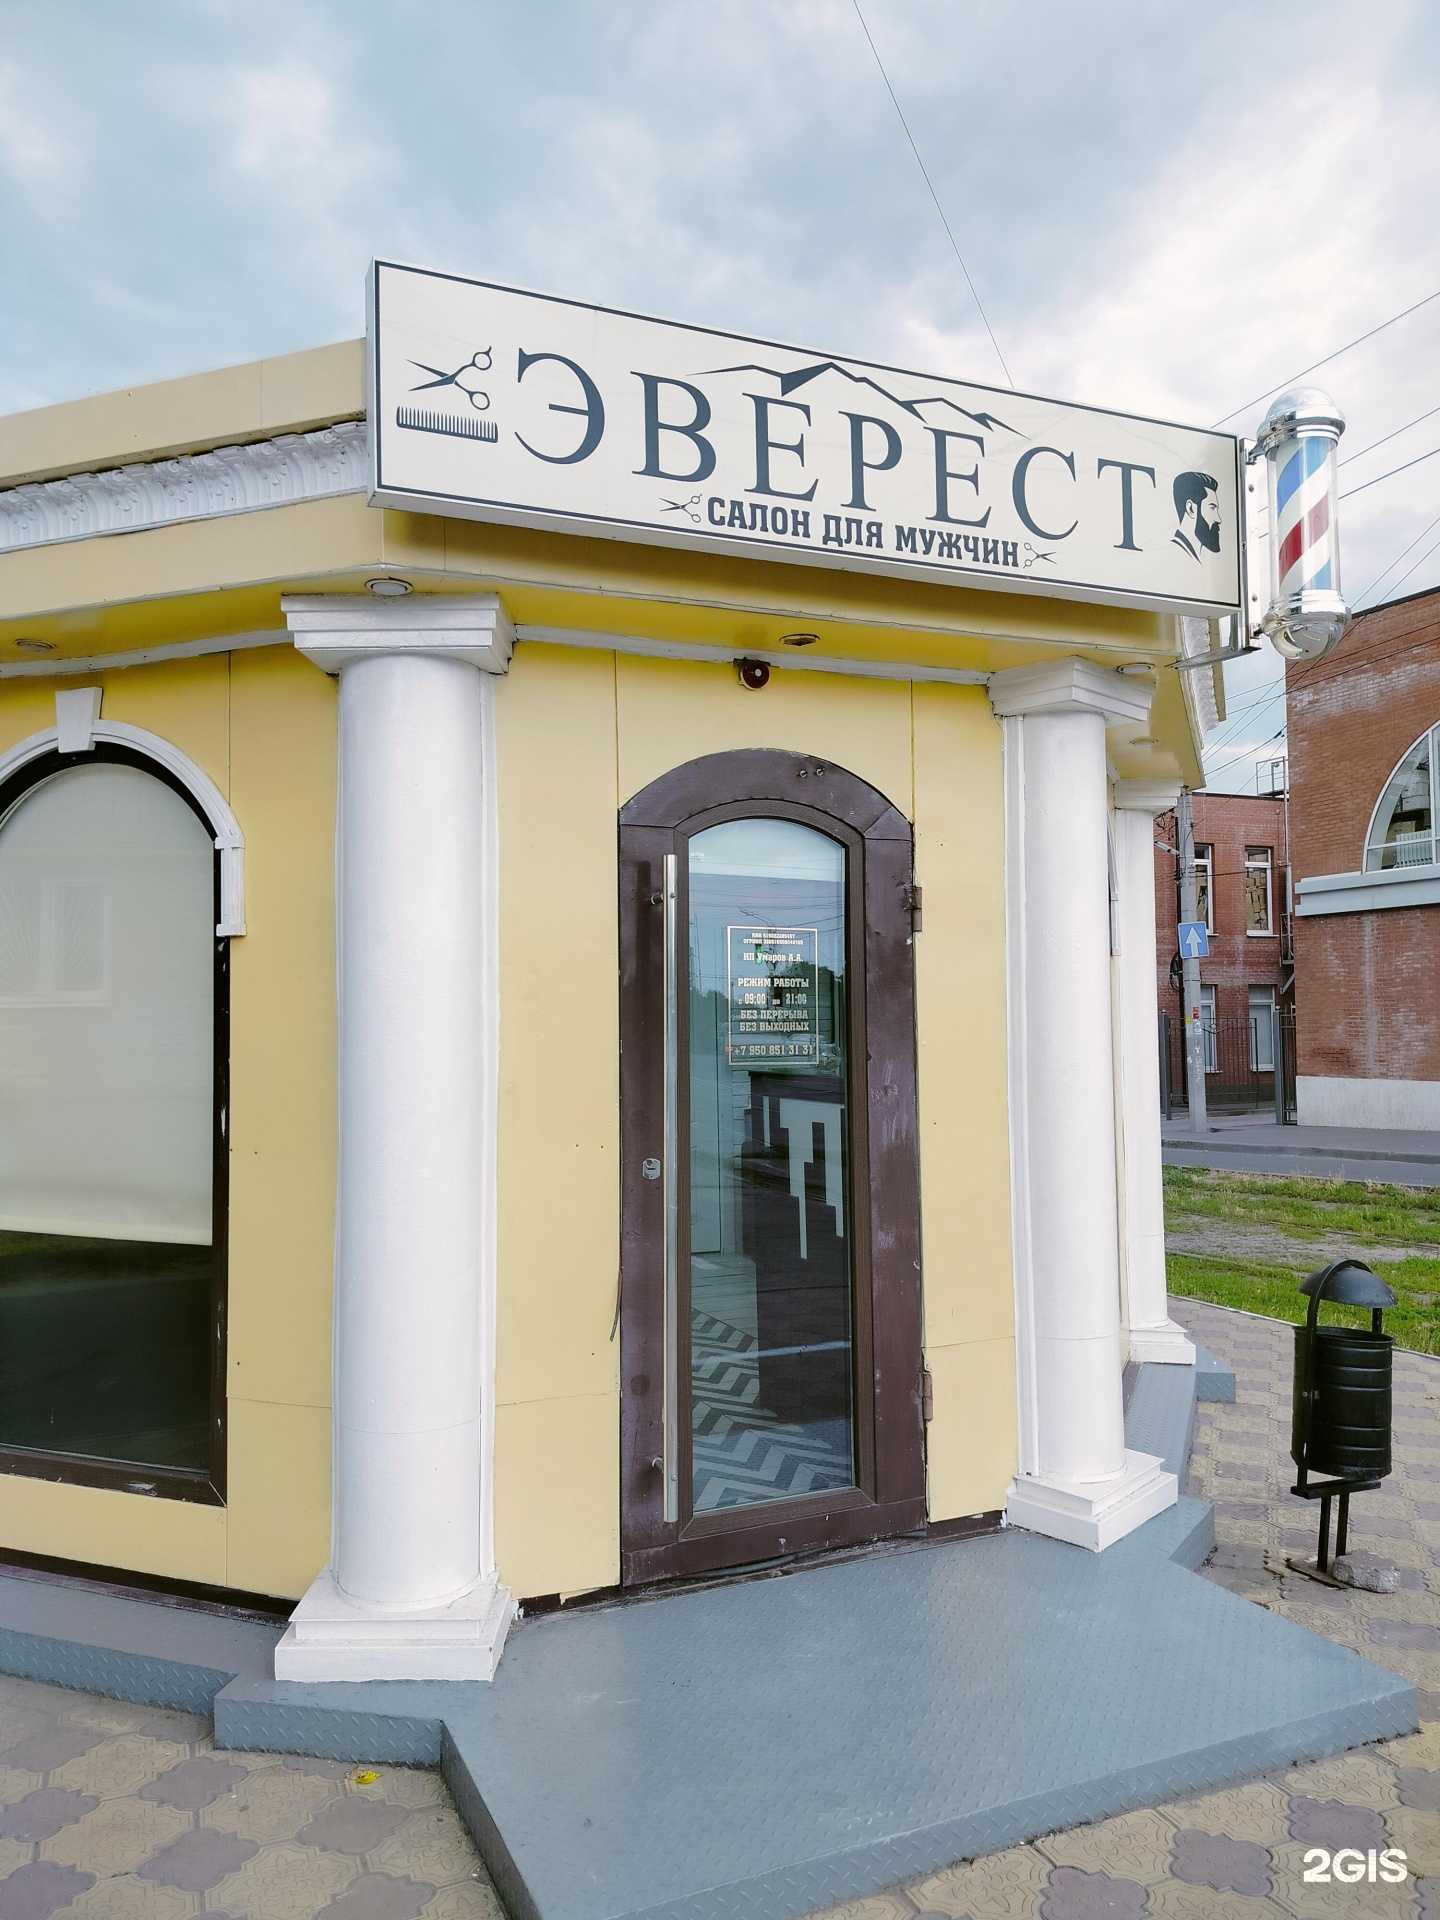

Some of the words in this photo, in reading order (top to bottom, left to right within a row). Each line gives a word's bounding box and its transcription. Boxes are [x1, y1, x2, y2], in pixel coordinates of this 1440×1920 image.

[513, 347, 1157, 553] ЭВЕРЕСТ
[707, 496, 811, 538] САЛОН
[822, 513, 884, 548] ДЛЯ
[895, 524, 1019, 568] МУЖЧИН
[737, 978, 771, 988] РЕЖИМ
[773, 978, 809, 988] РАБОТЫ
[744, 994, 766, 1005] 09:00
[785, 994, 807, 1005] 21:00
[740, 1010, 758, 1019] БЕЗ
[760, 1010, 809, 1020] ПЕРЕРЫВА
[739, 1022, 757, 1031] БЕЗ
[759, 1022, 810, 1032] ВЫХОДНЫХ
[734, 1046, 746, 1056] +7
[769, 1046, 785, 1056] 851
[788, 1045, 799, 1055] 31
[802, 1045, 814, 1055] 31
